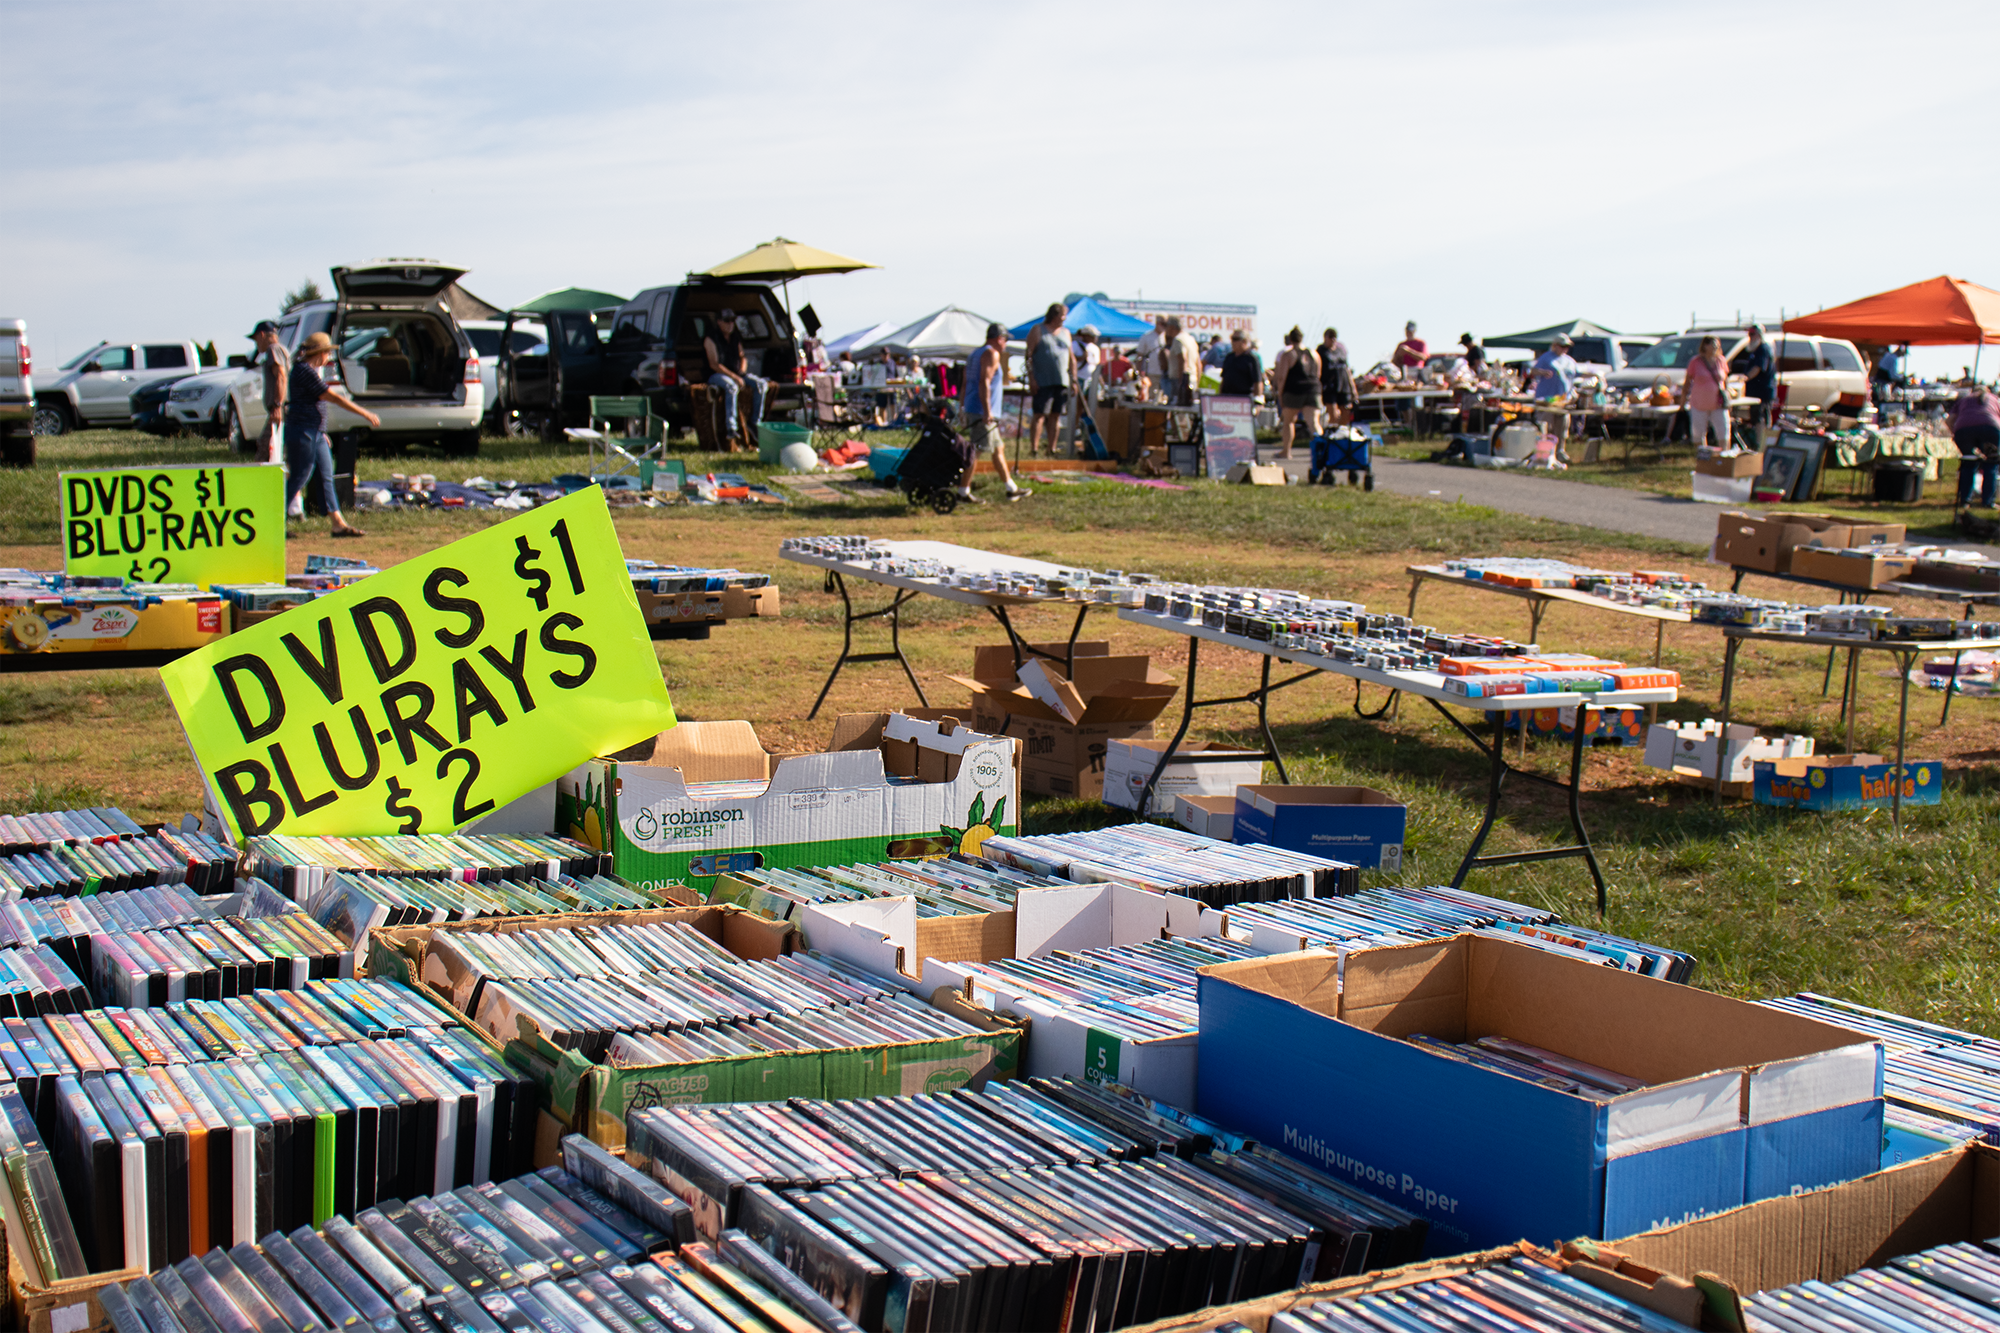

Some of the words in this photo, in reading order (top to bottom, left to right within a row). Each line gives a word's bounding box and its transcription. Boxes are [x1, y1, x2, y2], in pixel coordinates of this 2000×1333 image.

[1226, 317, 1254, 332] RETAIL
[1212, 401, 1242, 412] MUSTANG
[68, 475, 174, 516] DVDS
[196, 468, 225, 507] $1
[69, 510, 256, 558] BLU-RAYS
[128, 558, 171, 584] $2
[652, 606, 678, 618] GEM
[695, 603, 723, 614] PACK
[92, 618, 128, 632] Zespri
[213, 567, 484, 742] DVDS
[514, 519, 585, 611] $1
[215, 612, 596, 836] BLU-RAYS
[976, 766, 997, 776] 1905
[1771, 779, 1810, 800] halos
[662, 808, 744, 825] robinson
[663, 825, 713, 839] FRESH
[1098, 1046, 1106, 1068] 5
[1284, 1123, 1396, 1190] Multipurpose
[1401, 1173, 1458, 1214] Paper
[21, 1196, 35, 1223] CASPER
[1433, 1220, 1469, 1243] printing
[596, 1306, 614, 1319] THE
[616, 1298, 648, 1321] AFTER
[540, 1315, 566, 1332] GHO
